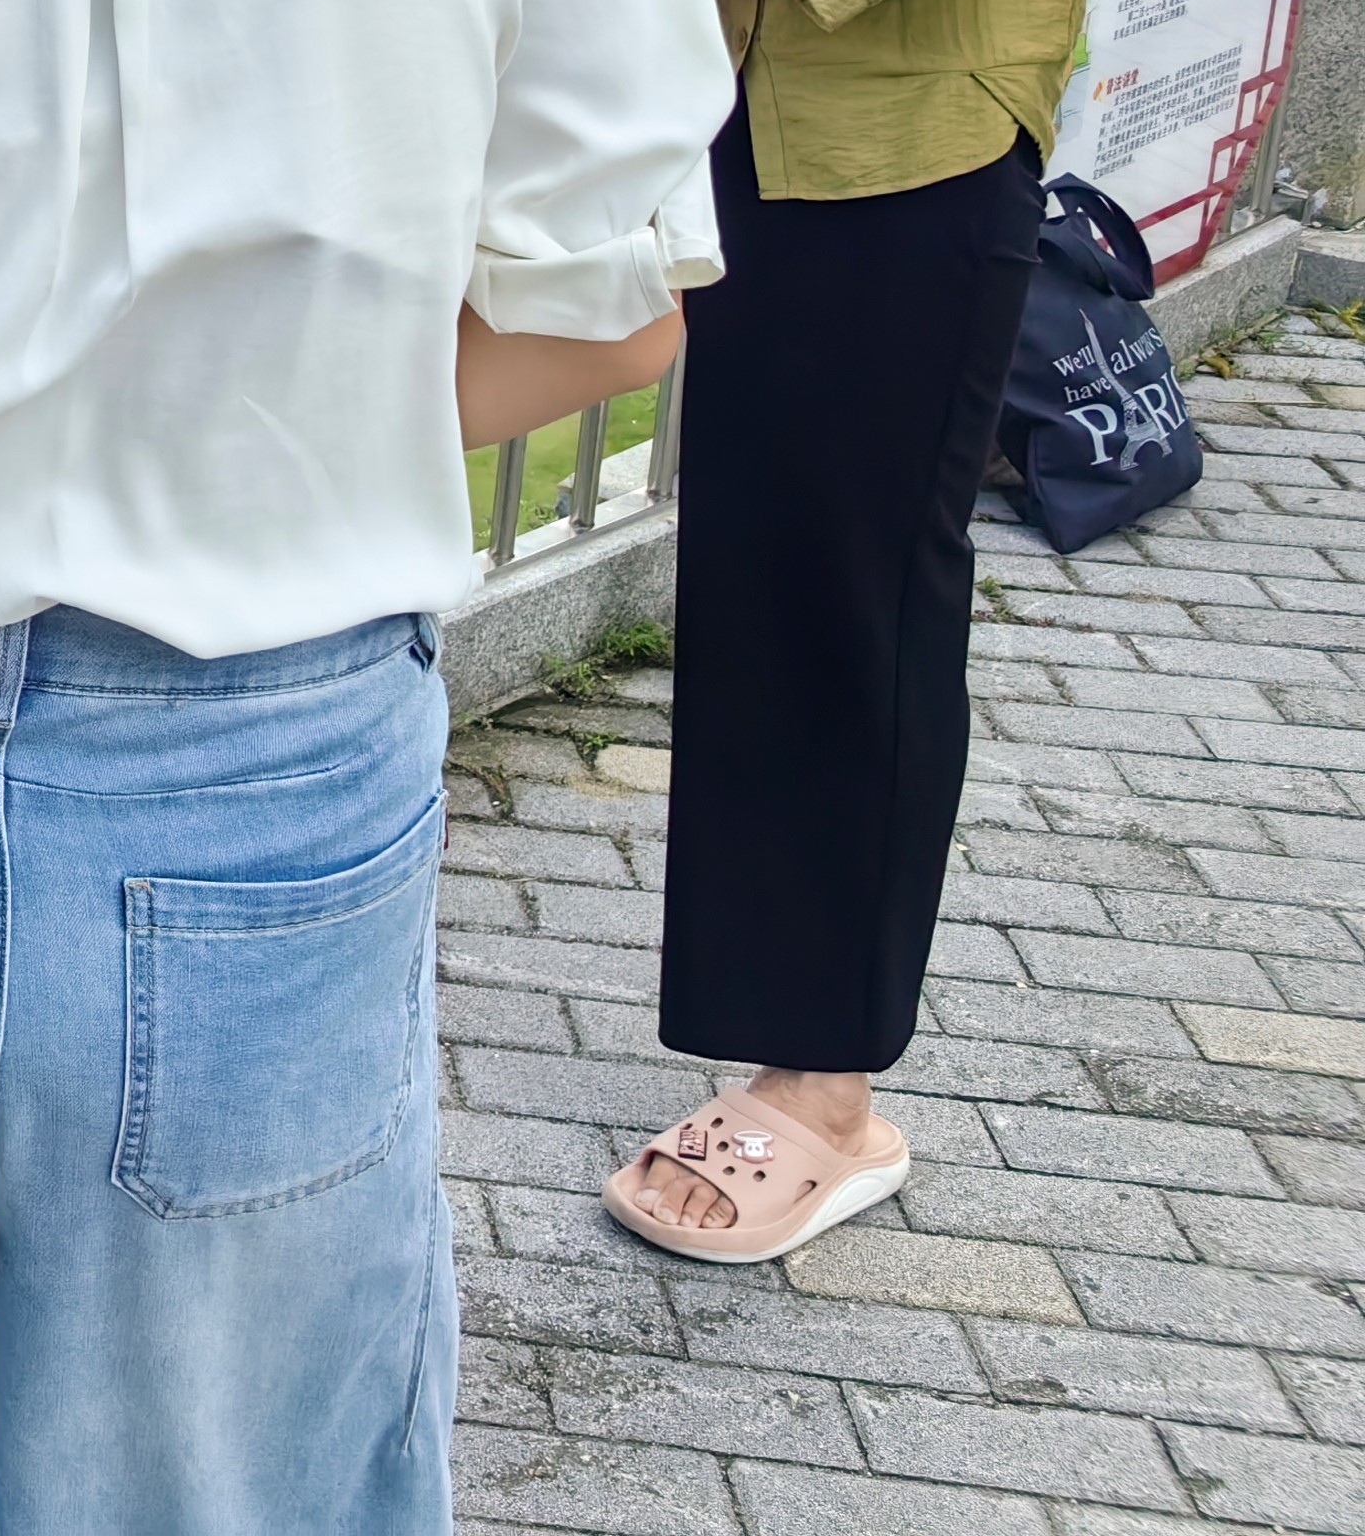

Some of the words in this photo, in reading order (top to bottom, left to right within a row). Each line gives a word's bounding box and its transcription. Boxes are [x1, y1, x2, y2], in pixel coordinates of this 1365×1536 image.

[1052, 344, 1096, 377] We'll
[1110, 326, 1165, 375] always
[1063, 376, 1113, 404] have
[1064, 365, 1189, 470] PARI
